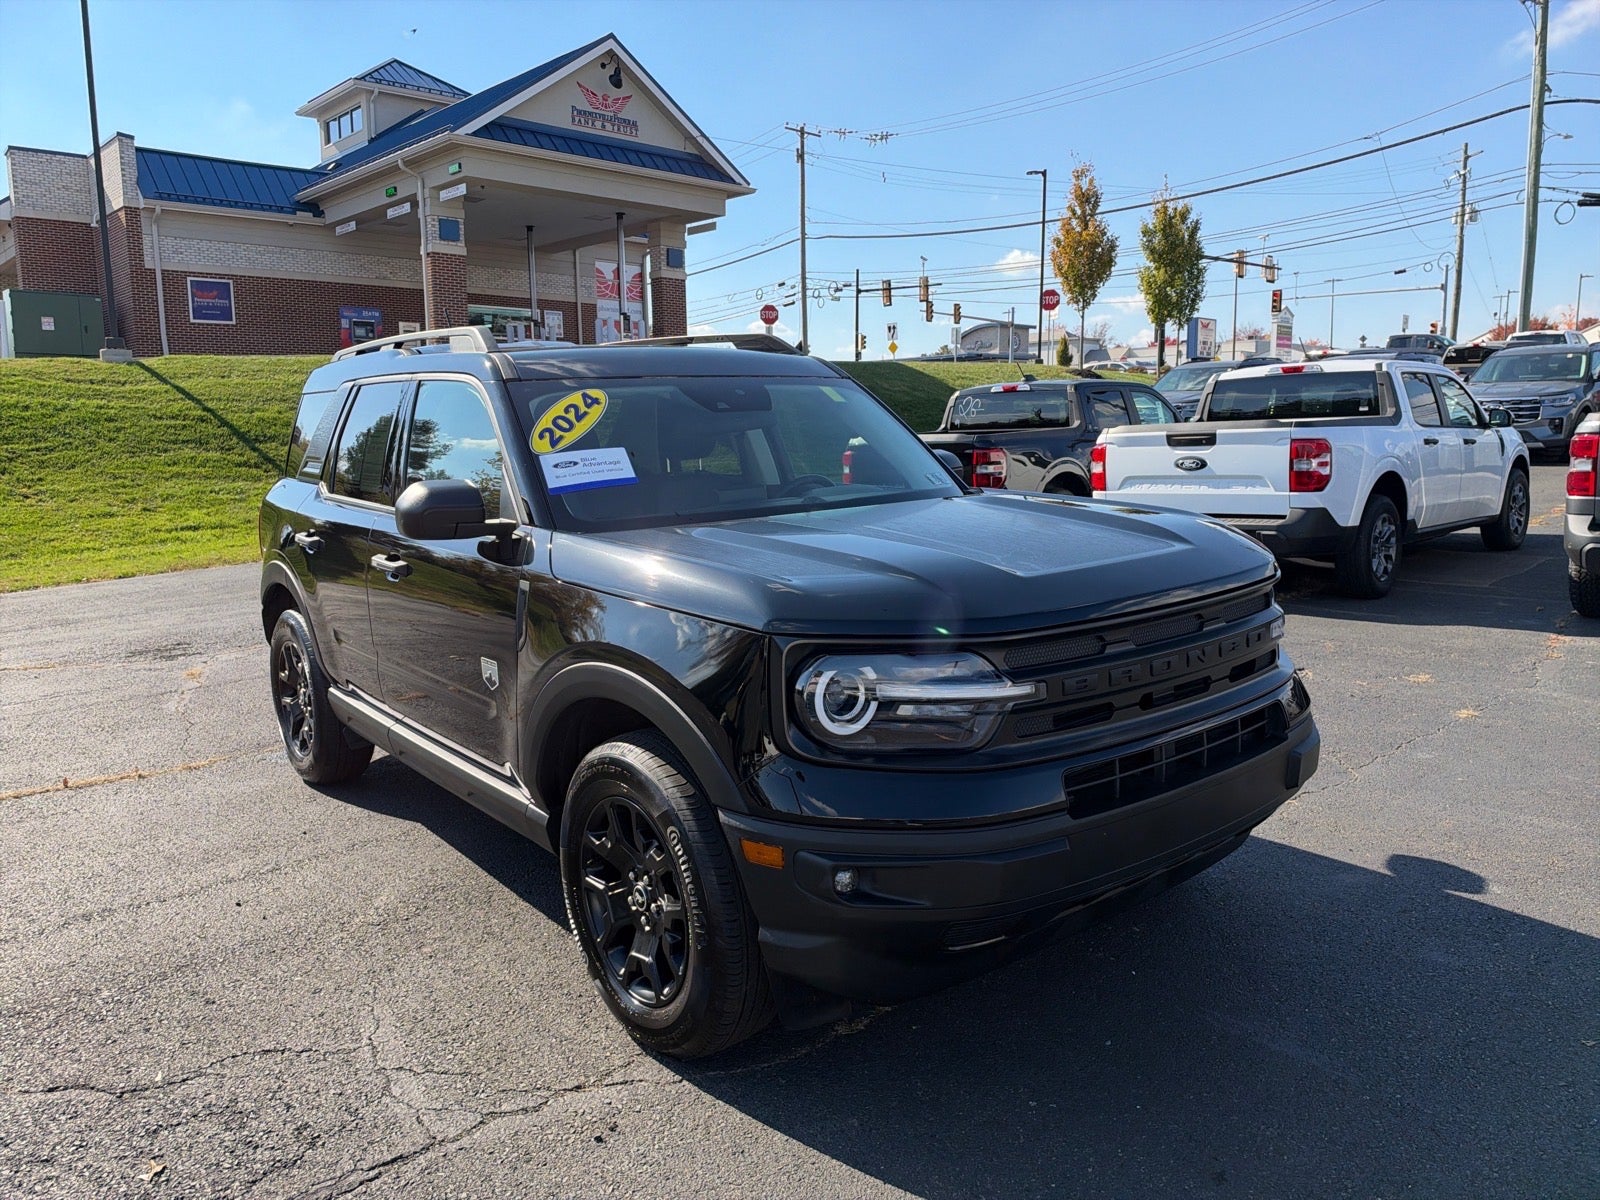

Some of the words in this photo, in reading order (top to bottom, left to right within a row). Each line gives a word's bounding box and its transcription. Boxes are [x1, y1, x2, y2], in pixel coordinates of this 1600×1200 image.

[571, 116, 597, 128] BANK
[610, 123, 639, 136] TRUST
[1042, 295, 1059, 304] STOP
[761, 310, 778, 319] STOP
[538, 392, 602, 449] 2024
[582, 459, 621, 468] Advantage
[1061, 627, 1267, 697] BRONCO
